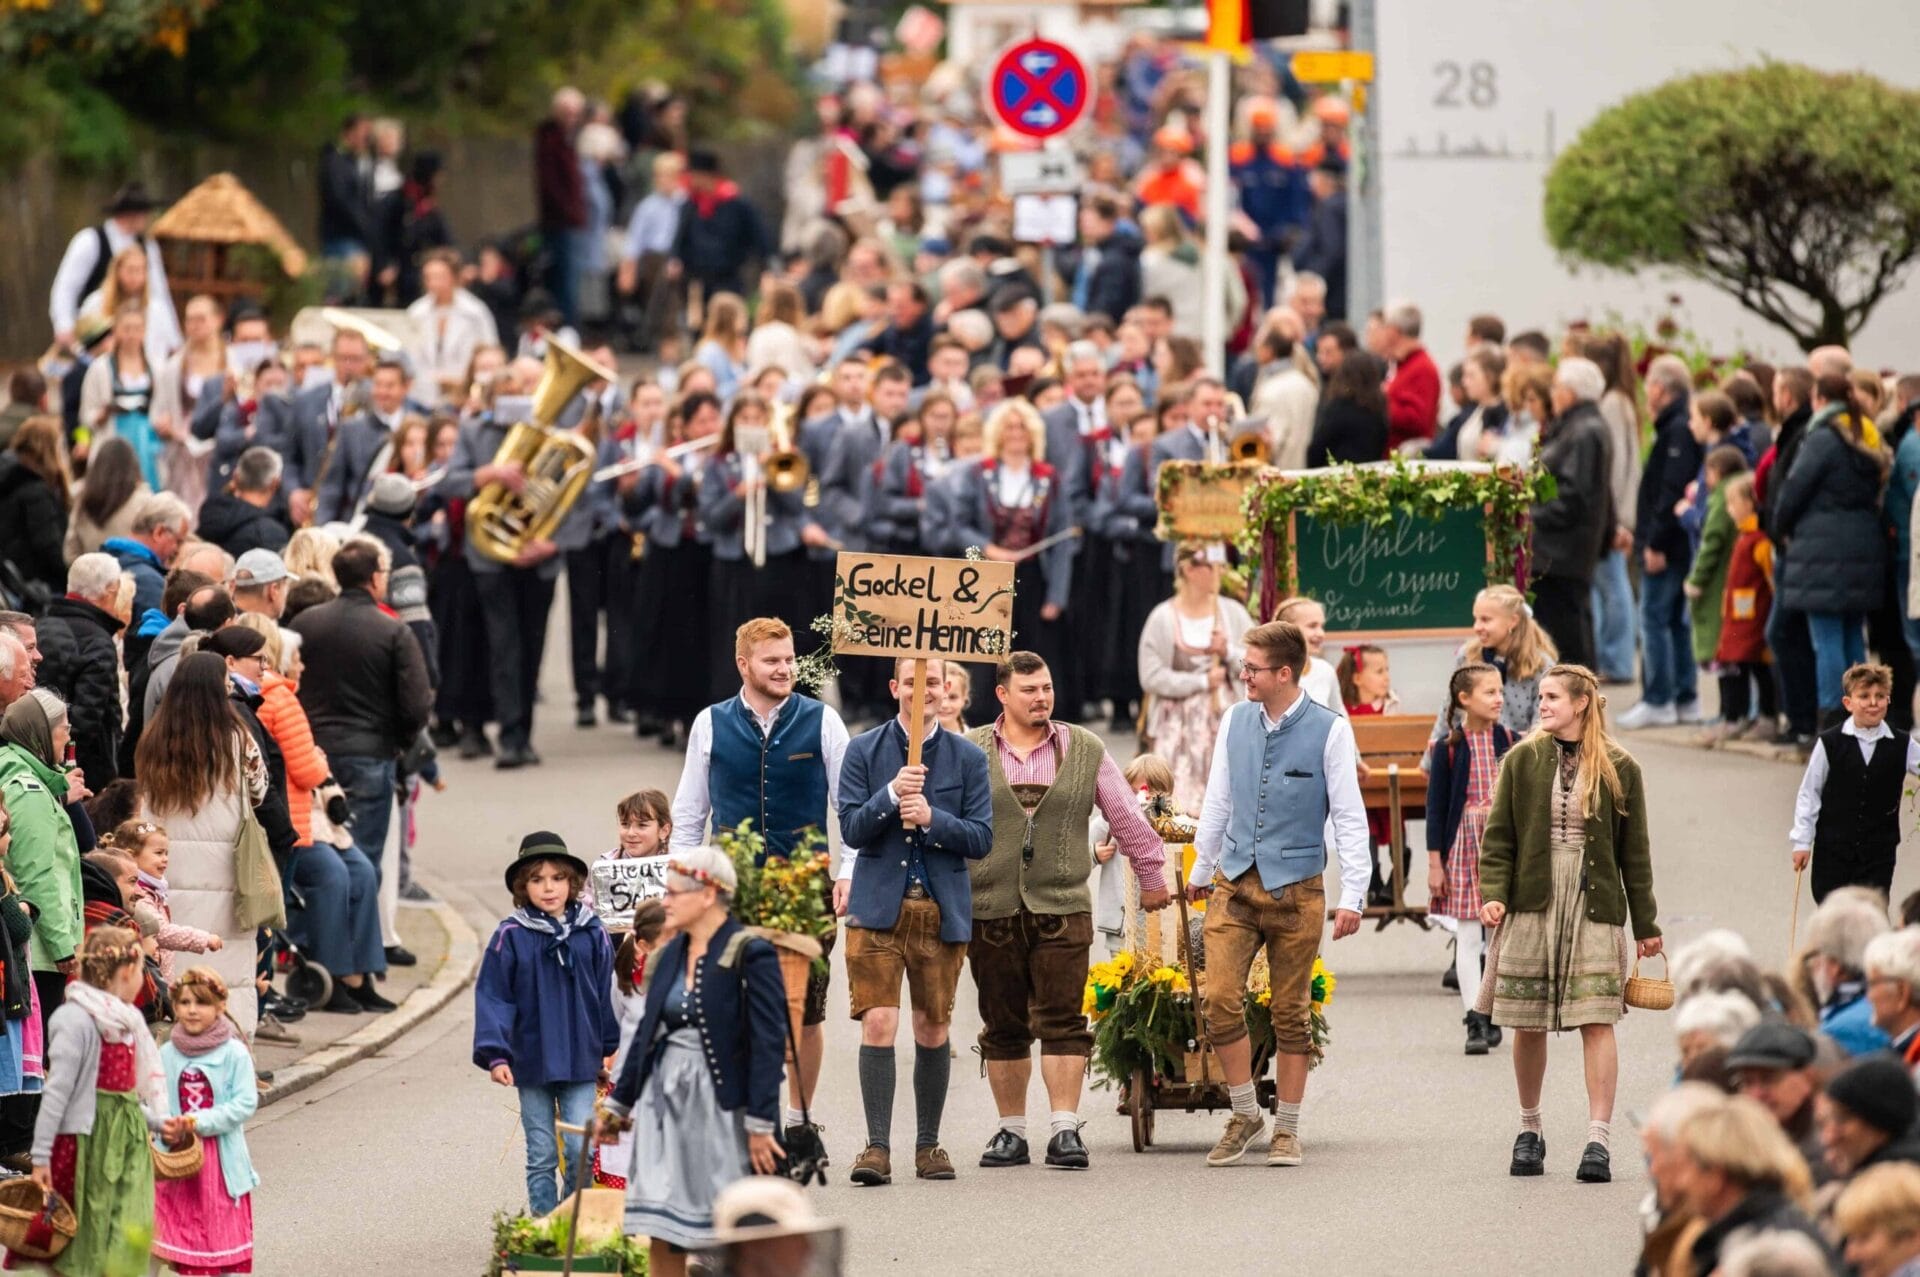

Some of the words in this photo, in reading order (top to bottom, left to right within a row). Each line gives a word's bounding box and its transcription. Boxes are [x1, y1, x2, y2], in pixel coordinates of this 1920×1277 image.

[1432, 60, 1497, 108] 28
[849, 562, 941, 603] Gockel
[952, 567, 979, 603] &
